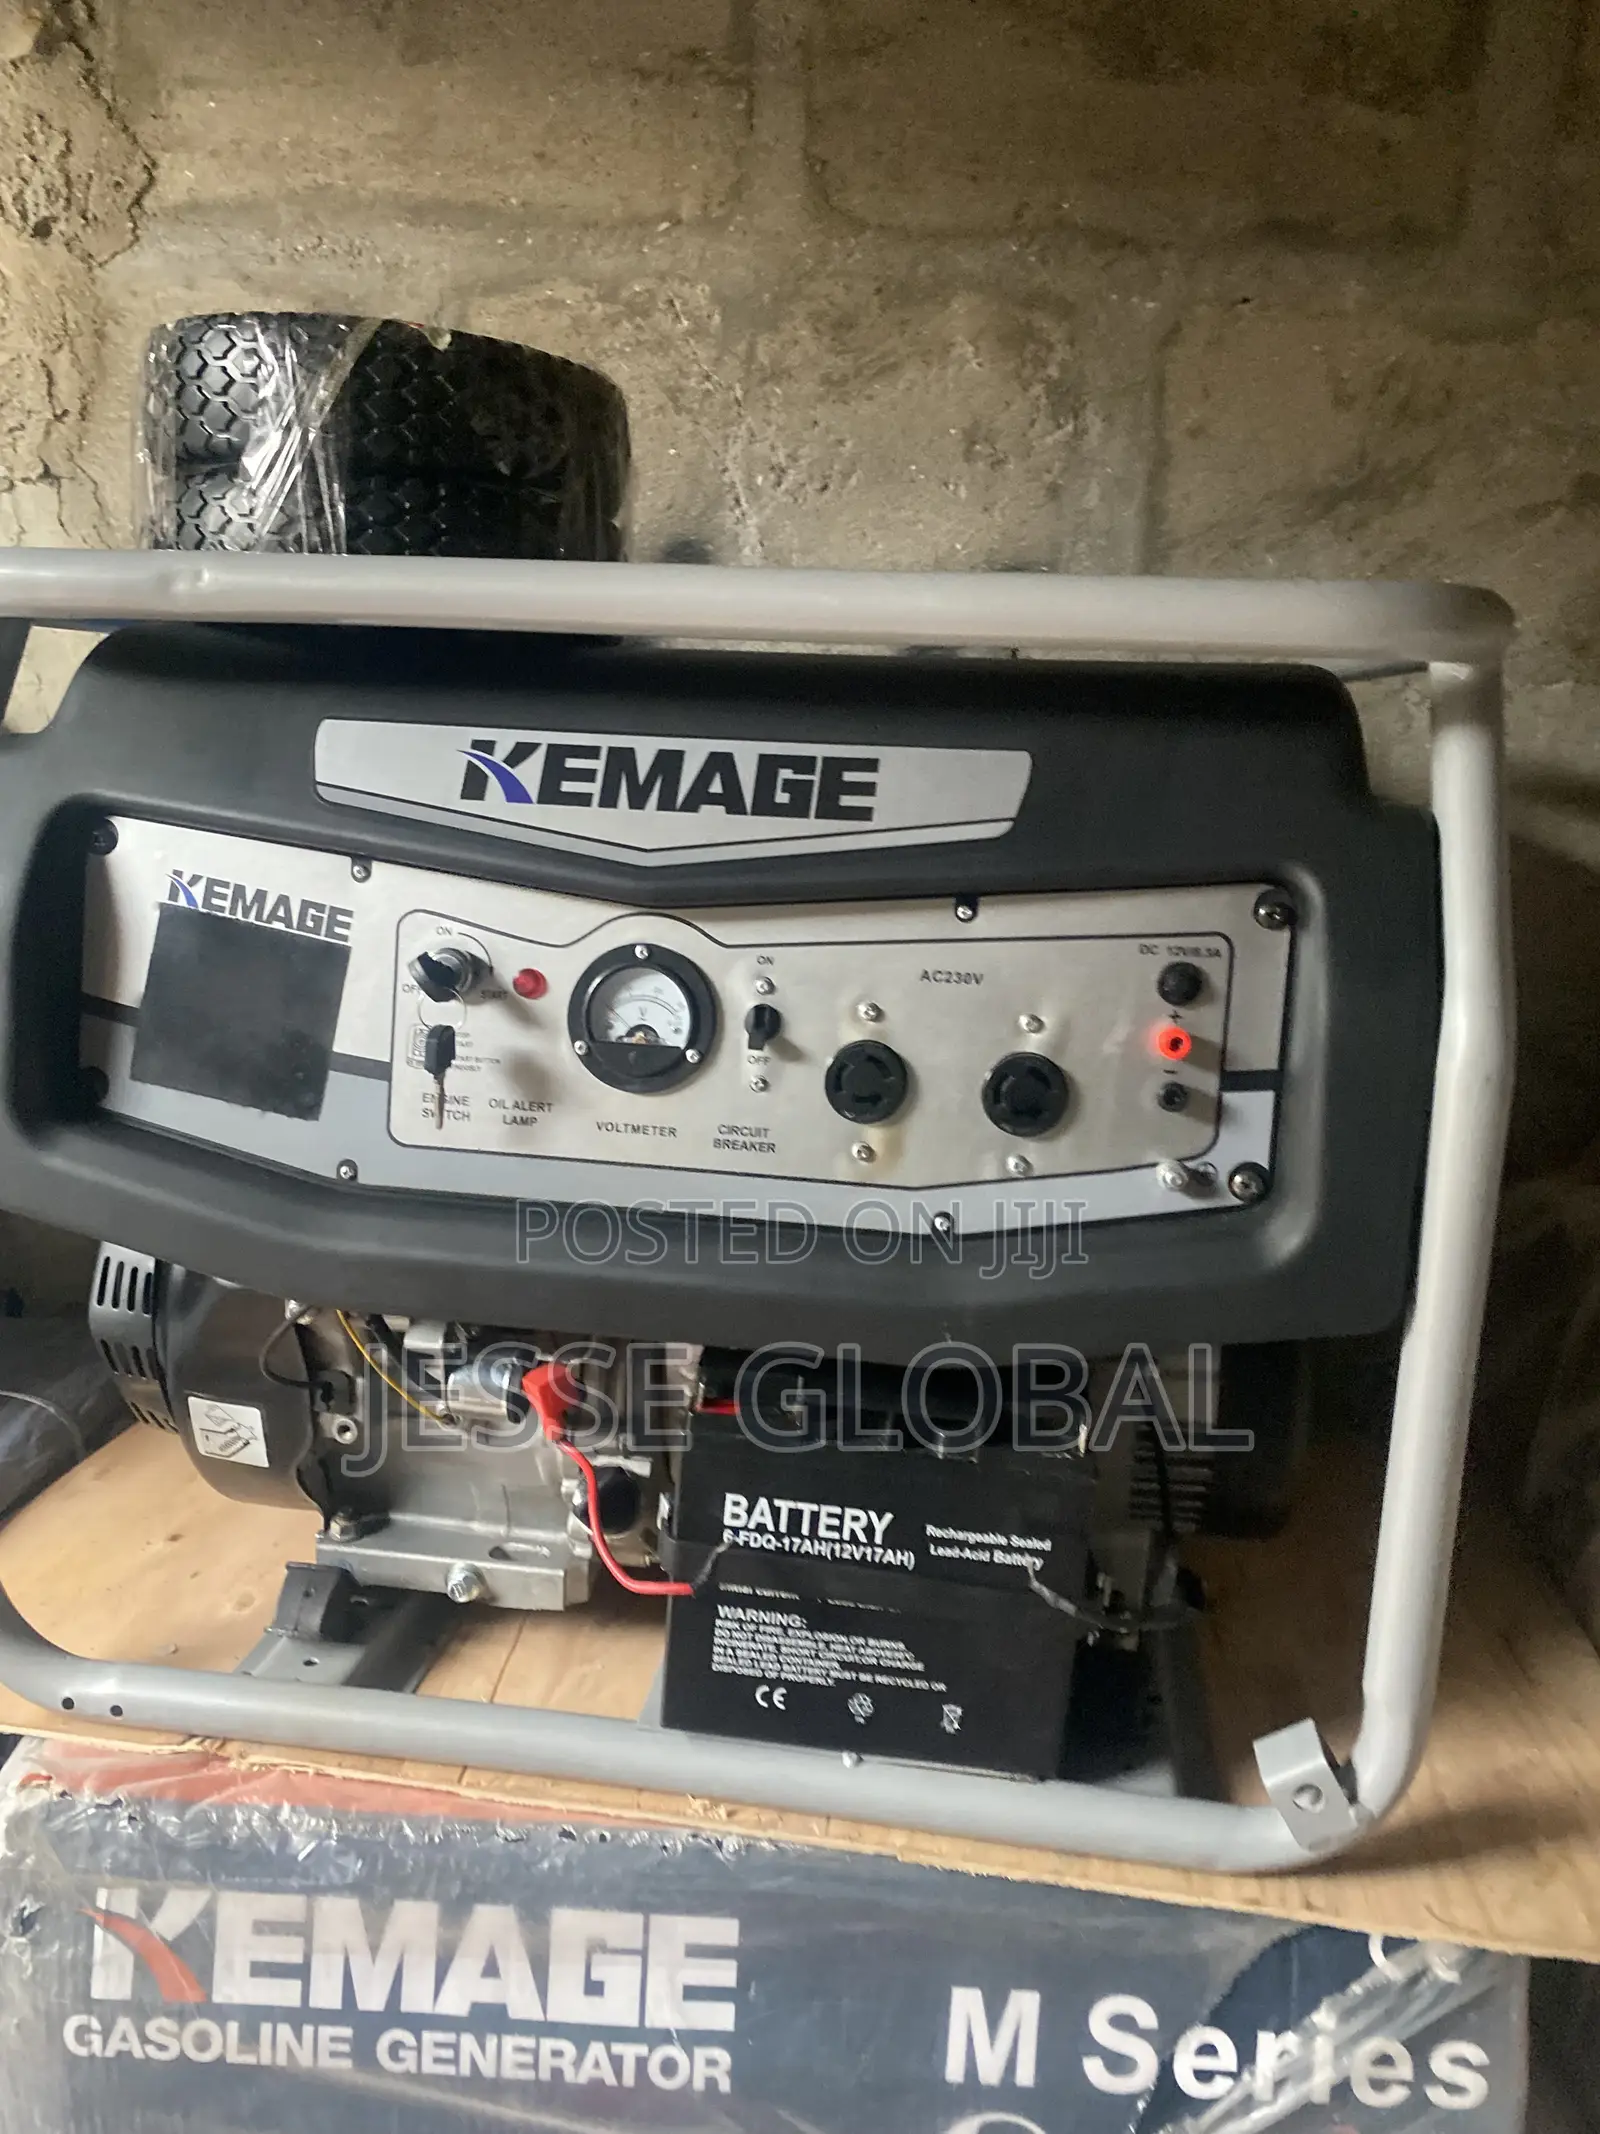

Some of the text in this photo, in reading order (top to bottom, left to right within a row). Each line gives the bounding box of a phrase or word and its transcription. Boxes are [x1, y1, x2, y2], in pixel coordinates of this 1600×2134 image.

[457, 739, 881, 822] KEMAGE
[165, 869, 355, 943] KEMAGE
[436, 926, 452, 937] ON
[1139, 943, 1160, 955] DC
[756, 955, 775, 966] ON
[919, 968, 985, 986] AC230V
[747, 1055, 772, 1066] OFF
[422, 1092, 471, 1107] ENINE
[488, 1098, 554, 1113] OIL ALERT
[421, 1107, 471, 1122] STCH
[502, 1114, 538, 1126] LAMP
[596, 1121, 678, 1138] VOLTMETER
[717, 1123, 771, 1138] CIRCUIT
[713, 1138, 776, 1153] BREAKER
[723, 1492, 895, 1545] BATTERY
[925, 1523, 1052, 1552] Rechargeable Sealed
[929, 1542, 1044, 1571] Lead-Acid Battery
[716, 1604, 808, 1629] WARNING:
[83, 1887, 741, 2032] KEMAGE
[62, 2014, 732, 2094] GASOLINE GENERATOR
[944, 1985, 1491, 2110] M Series
